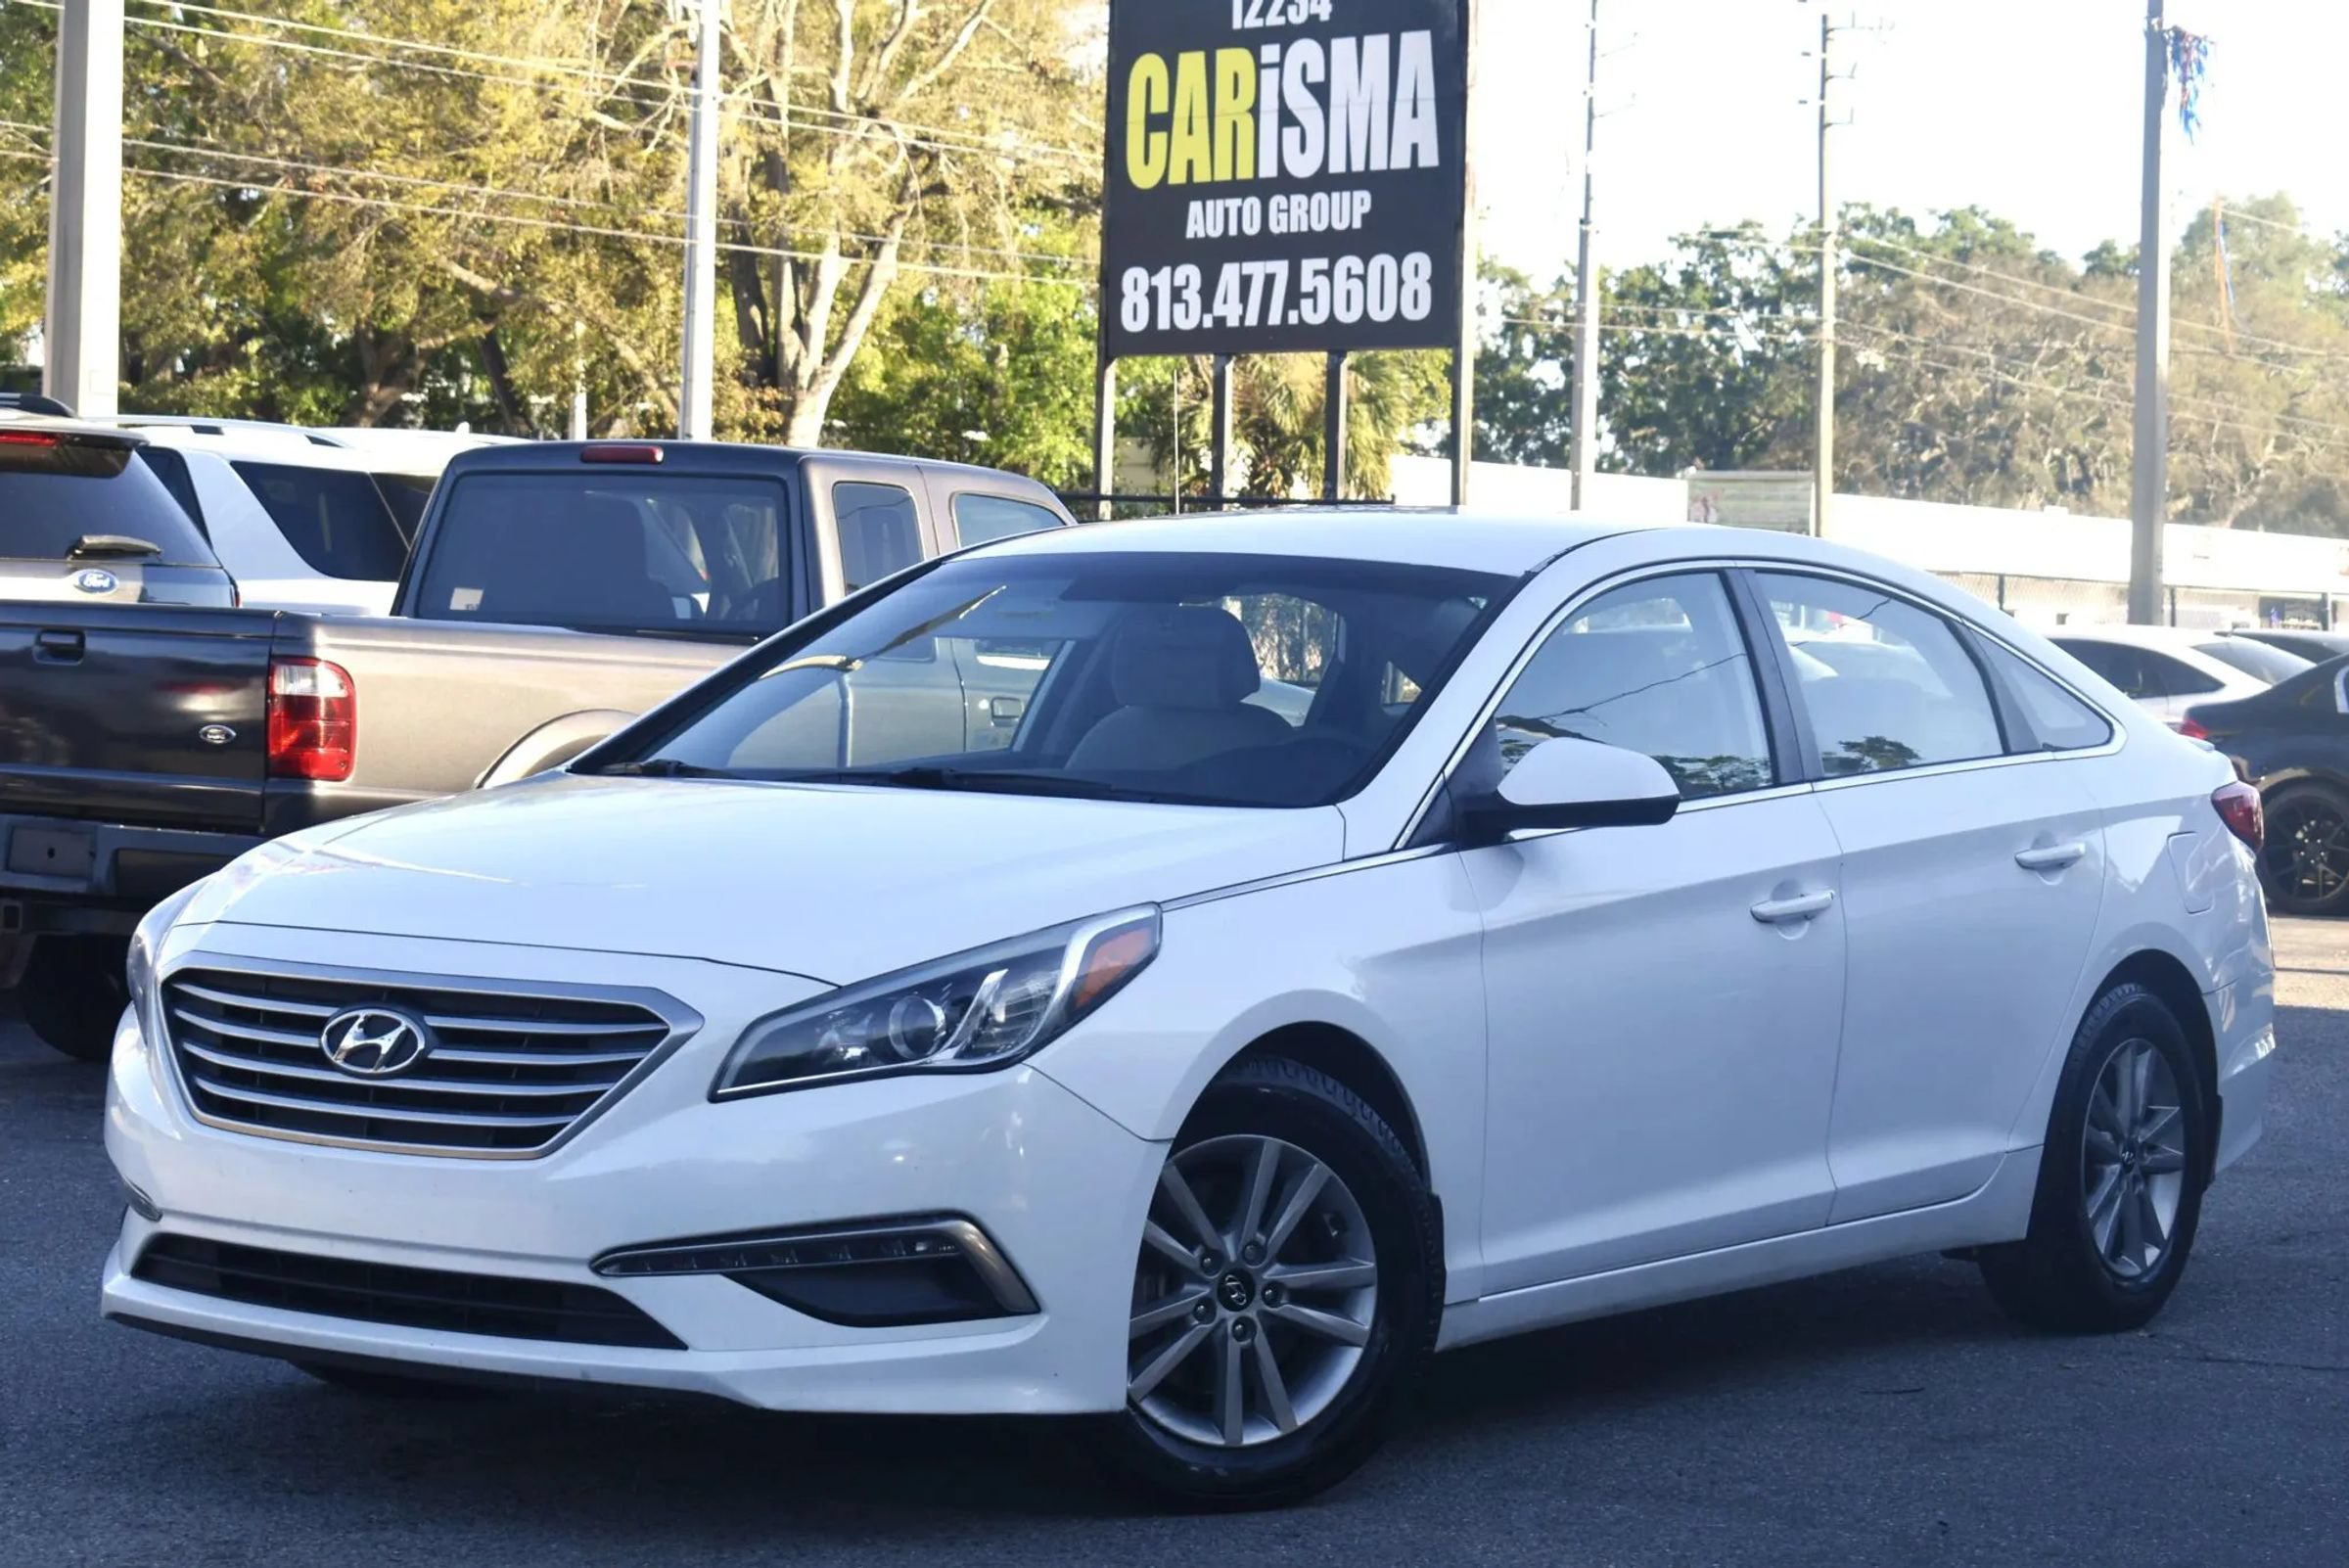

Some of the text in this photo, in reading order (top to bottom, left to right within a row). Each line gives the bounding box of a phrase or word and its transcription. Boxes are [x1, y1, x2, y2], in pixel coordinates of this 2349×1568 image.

[1127, 29, 1440, 189] CARiSMA
[1185, 190, 1372, 239] AUTO GROUP
[1121, 252, 1432, 333] 813.477.5608
